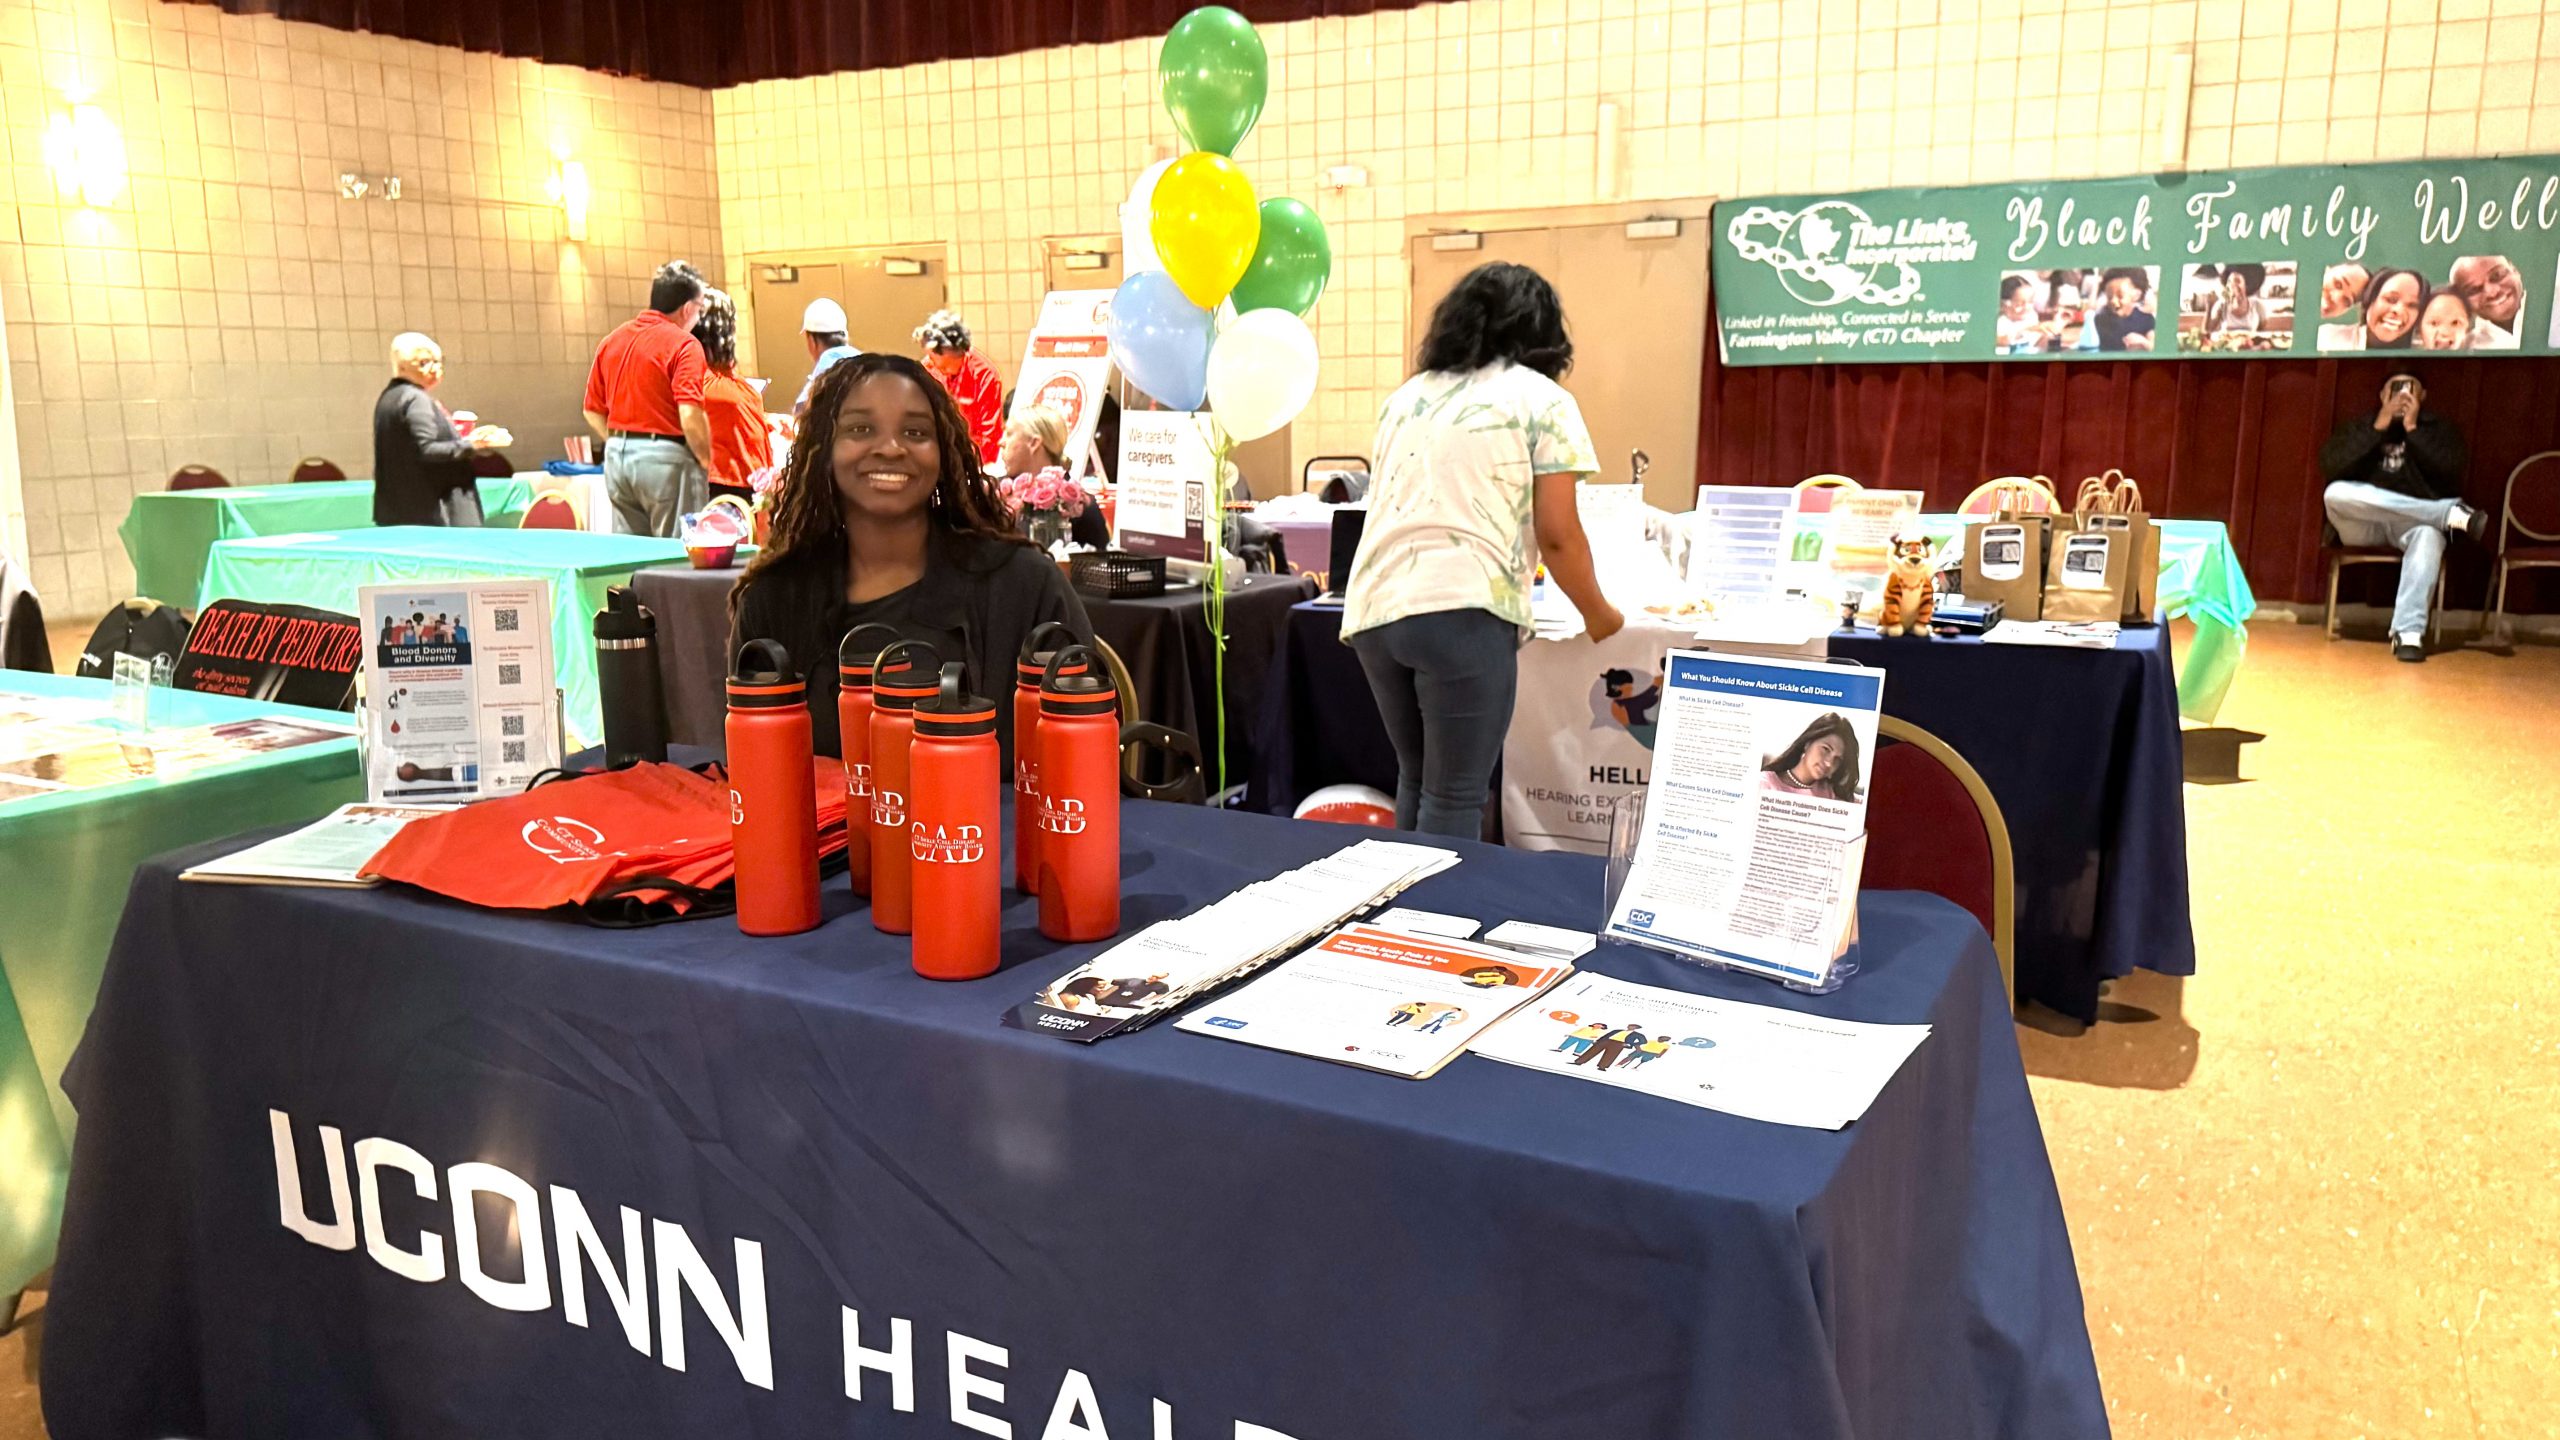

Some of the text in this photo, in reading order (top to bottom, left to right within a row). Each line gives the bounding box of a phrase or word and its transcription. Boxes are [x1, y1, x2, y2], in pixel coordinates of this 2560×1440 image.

[2005, 194, 2151, 262] Black
[2186, 180, 2380, 261] Family
[1850, 221, 1893, 247] The
[1845, 241, 1978, 266] Incorporated
[1725, 315, 1762, 329] Linked
[1764, 315, 1776, 327] in
[1842, 311, 1908, 326] Connected
[1910, 310, 1924, 324] in
[1926, 310, 1971, 324] Service
[1729, 327, 1966, 351] Farmington Valley (CT) Chapter
[1128, 428, 1177, 445] We care for
[1127, 450, 1176, 466] caregivers.
[189, 608, 262, 660] DEATH
[245, 615, 287, 663] BY
[392, 646, 457, 655] Blood Donors
[394, 654, 456, 665] and Diversity
[1681, 672, 1843, 698] What You Should Know About Sickle Cell Disease
[1526, 787, 1591, 807] HEARING
[911, 821, 984, 863] CAB
[1630, 911, 1652, 924] CDC
[1037, 1020, 1075, 1031] HEALTH
[1039, 1013, 1090, 1028] UCONN
[269, 1108, 775, 1390] UCONN
